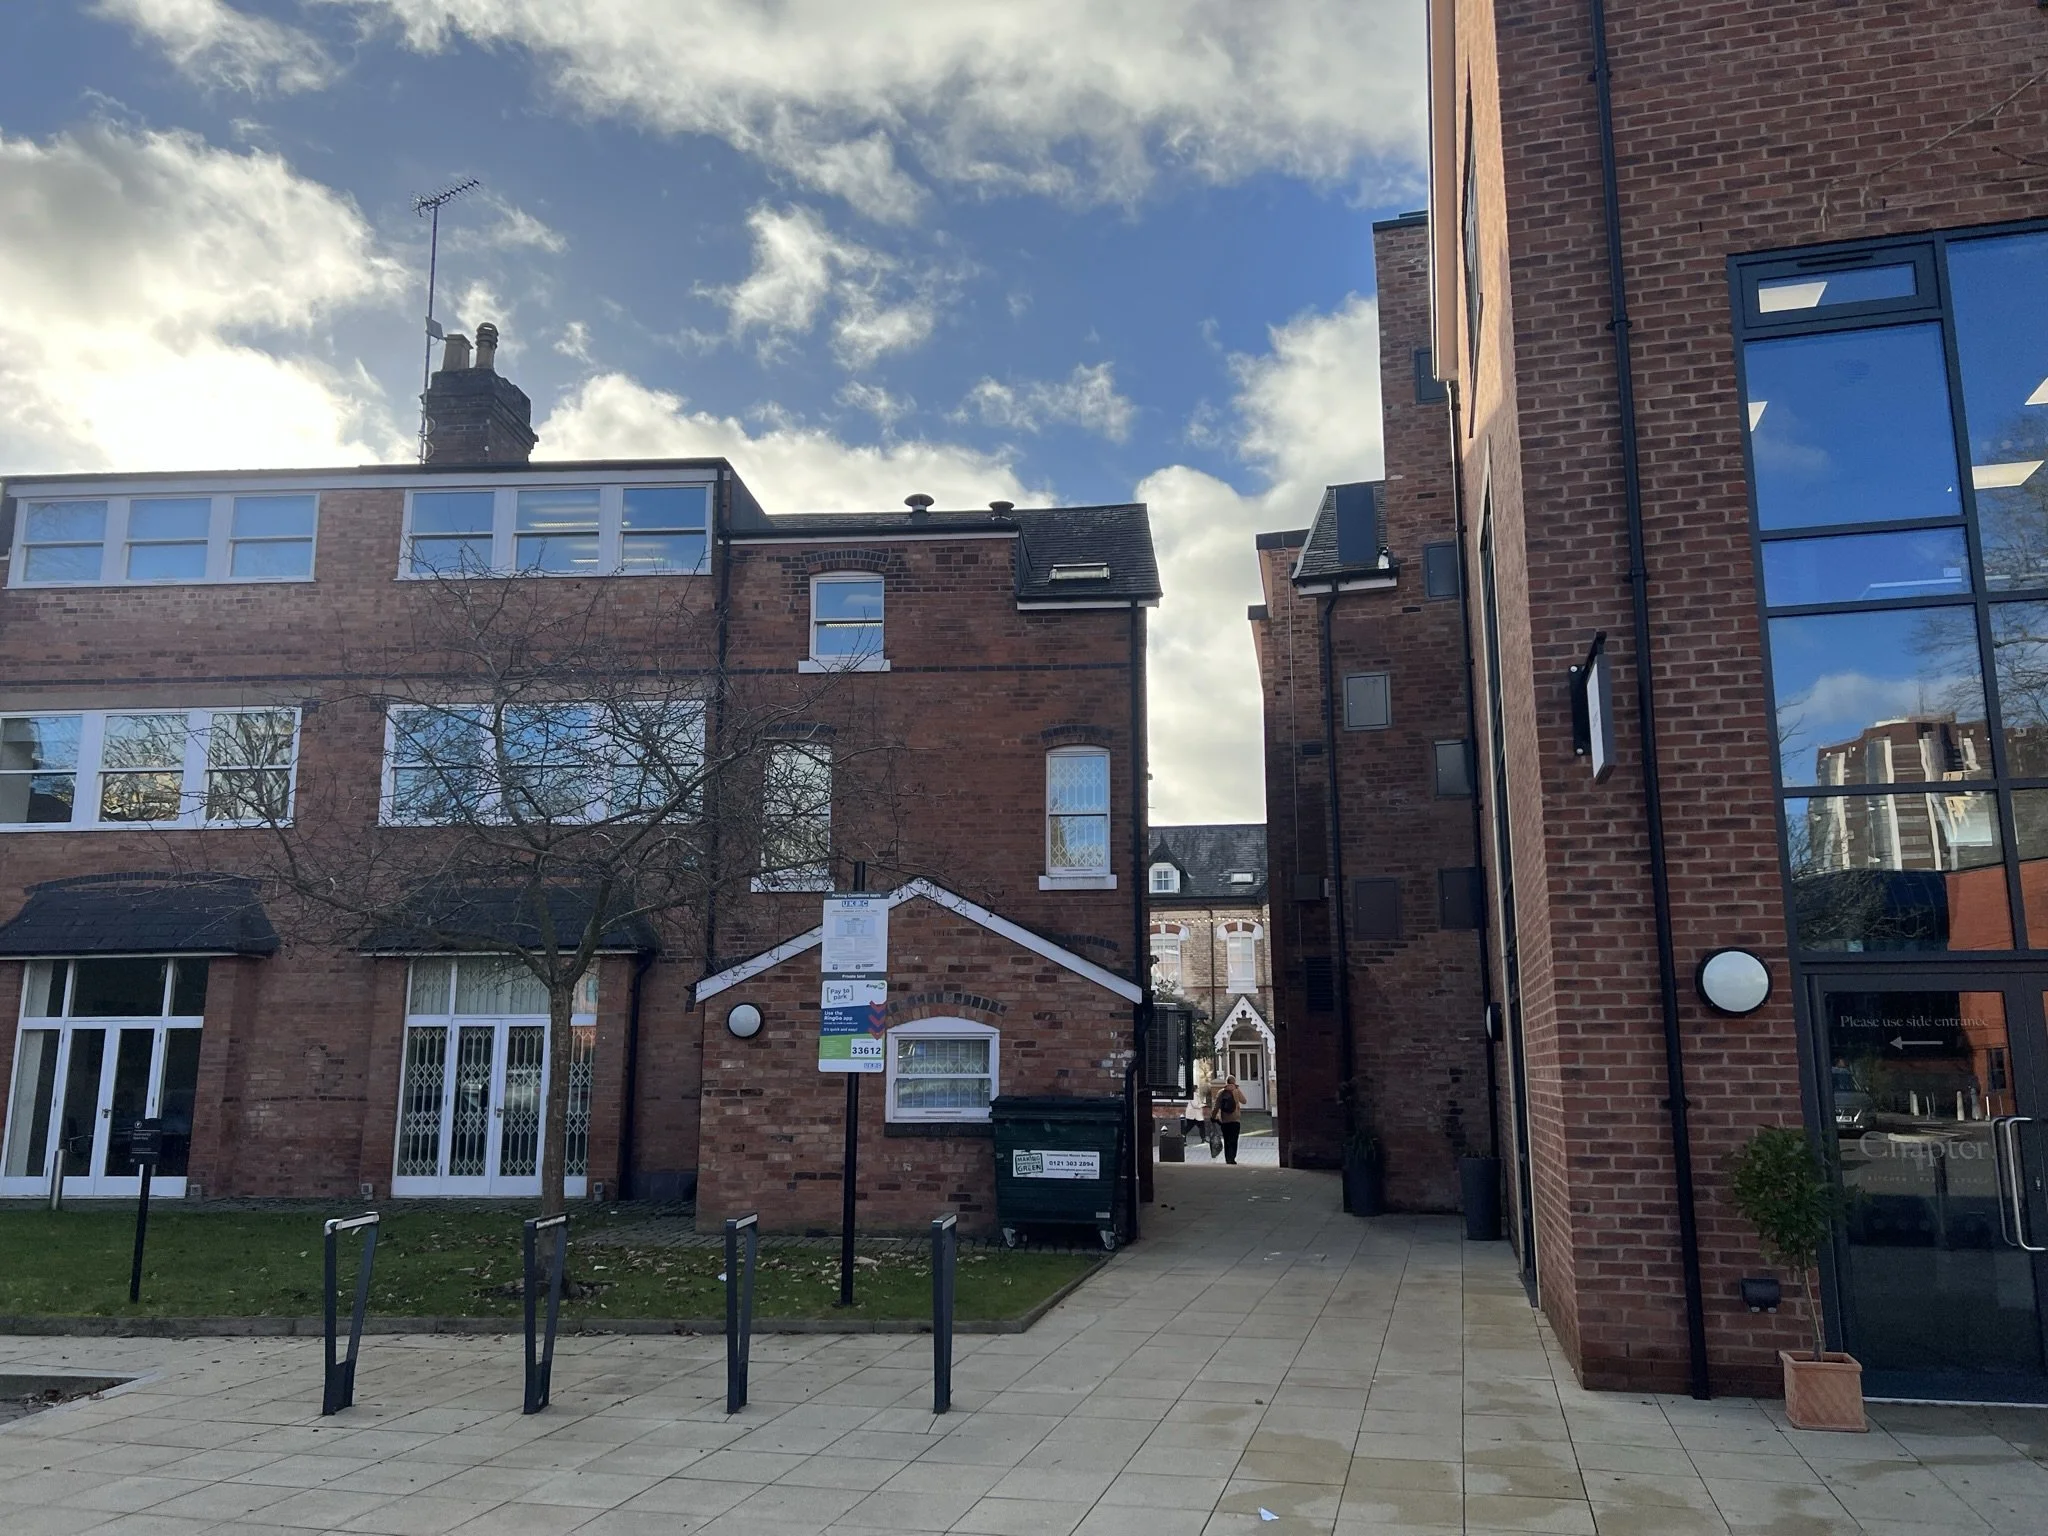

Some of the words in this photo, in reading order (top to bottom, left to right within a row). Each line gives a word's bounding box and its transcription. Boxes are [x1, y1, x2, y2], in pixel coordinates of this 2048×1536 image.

[1841, 1016, 1879, 1027] Please
[1883, 1018, 1904, 1026] use
[1906, 1016, 1932, 1026] side
[1935, 1018, 1988, 1027] entrance
